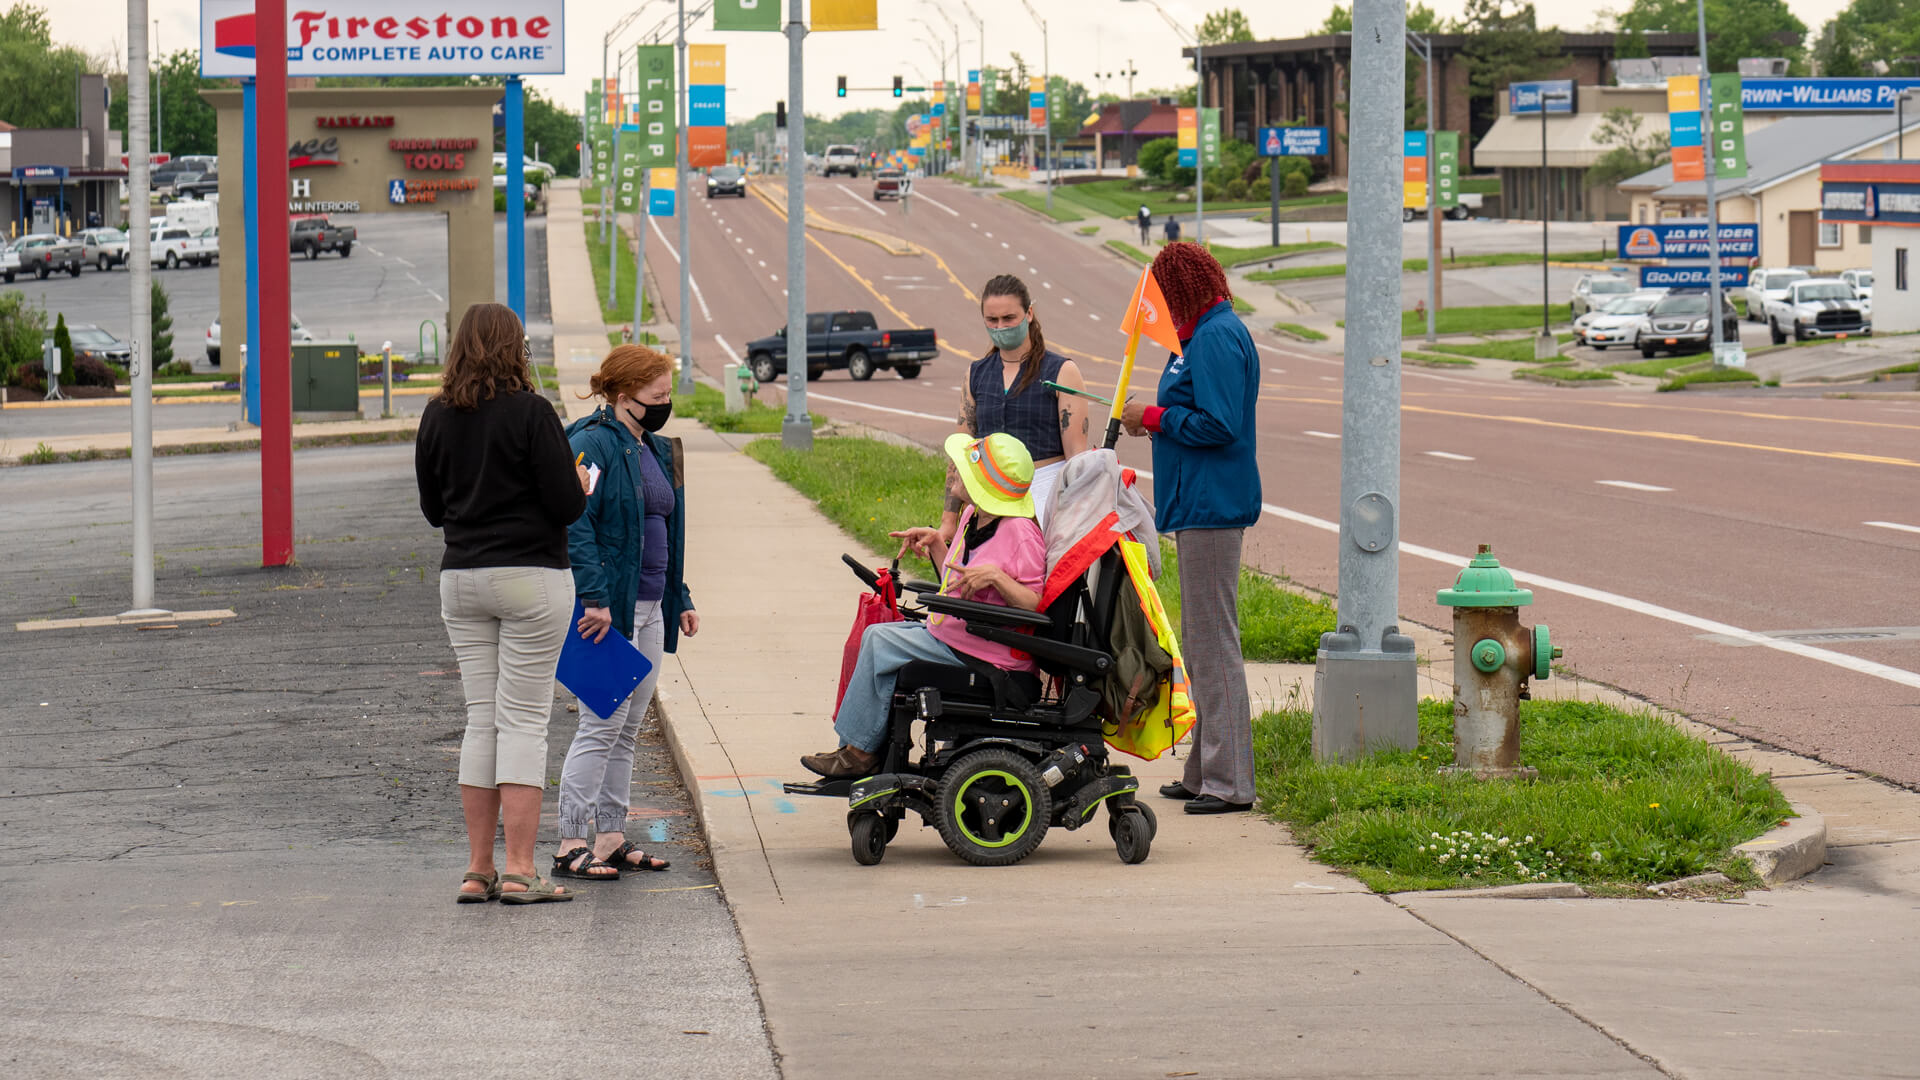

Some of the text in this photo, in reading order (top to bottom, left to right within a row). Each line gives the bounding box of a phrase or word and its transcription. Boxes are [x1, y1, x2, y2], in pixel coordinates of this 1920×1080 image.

[292, 10, 552, 47] Firestone
[312, 46, 545, 61] COMPLETE AUTO CARE
[648, 79, 664, 156] LOOP
[1719, 103, 1737, 169] LOOP
[389, 138, 479, 151] HARBOR FREIGHT
[403, 153, 466, 170] TOOLS
[405, 178, 480, 191] CONVENIENT
[620, 153, 635, 206] LOOP
[405, 192, 437, 203] CARE
[304, 201, 360, 212] INTERIORS
[1688, 228, 1754, 239] BYIDER
[1664, 243, 1684, 254] WE
